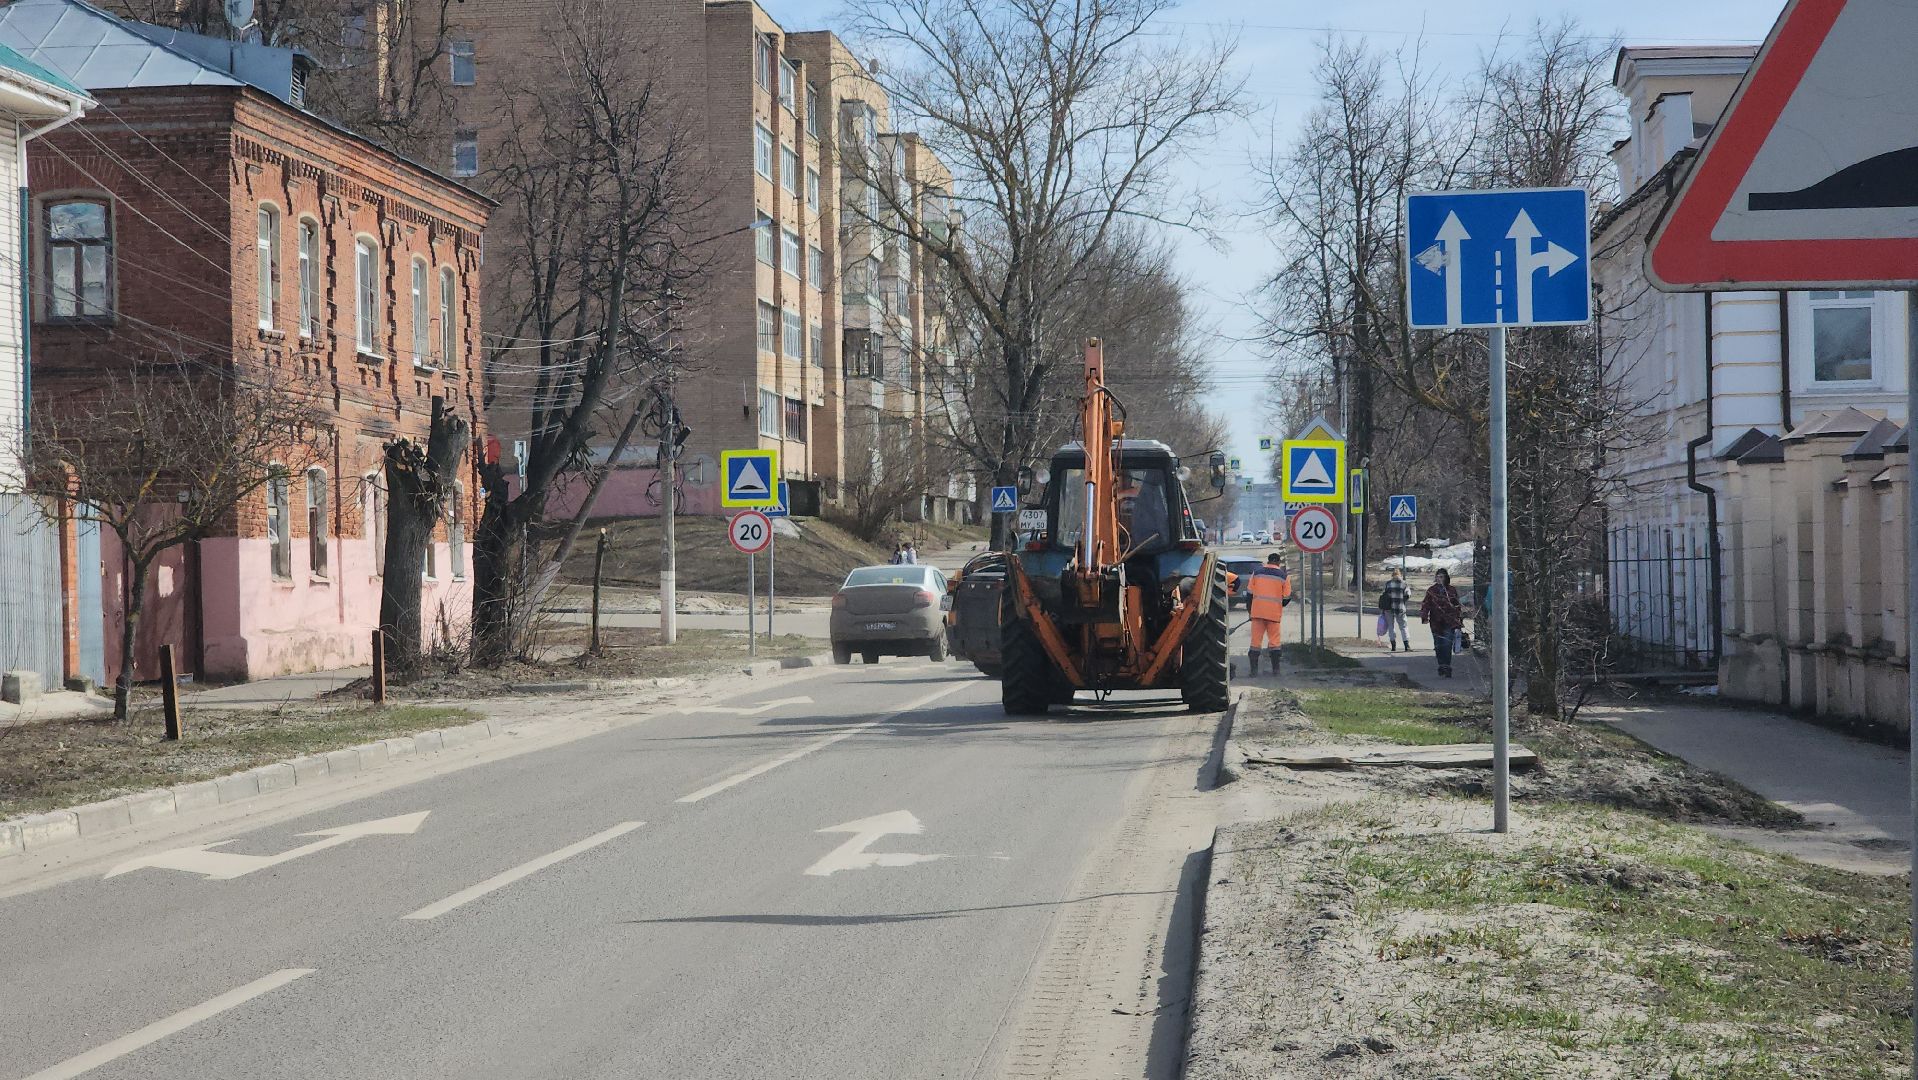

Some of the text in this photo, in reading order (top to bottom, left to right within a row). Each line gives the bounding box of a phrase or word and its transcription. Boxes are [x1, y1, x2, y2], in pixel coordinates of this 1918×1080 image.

[1022, 510, 1044, 519] 4307
[740, 524, 761, 540] 20
[1302, 521, 1326, 539] 20
